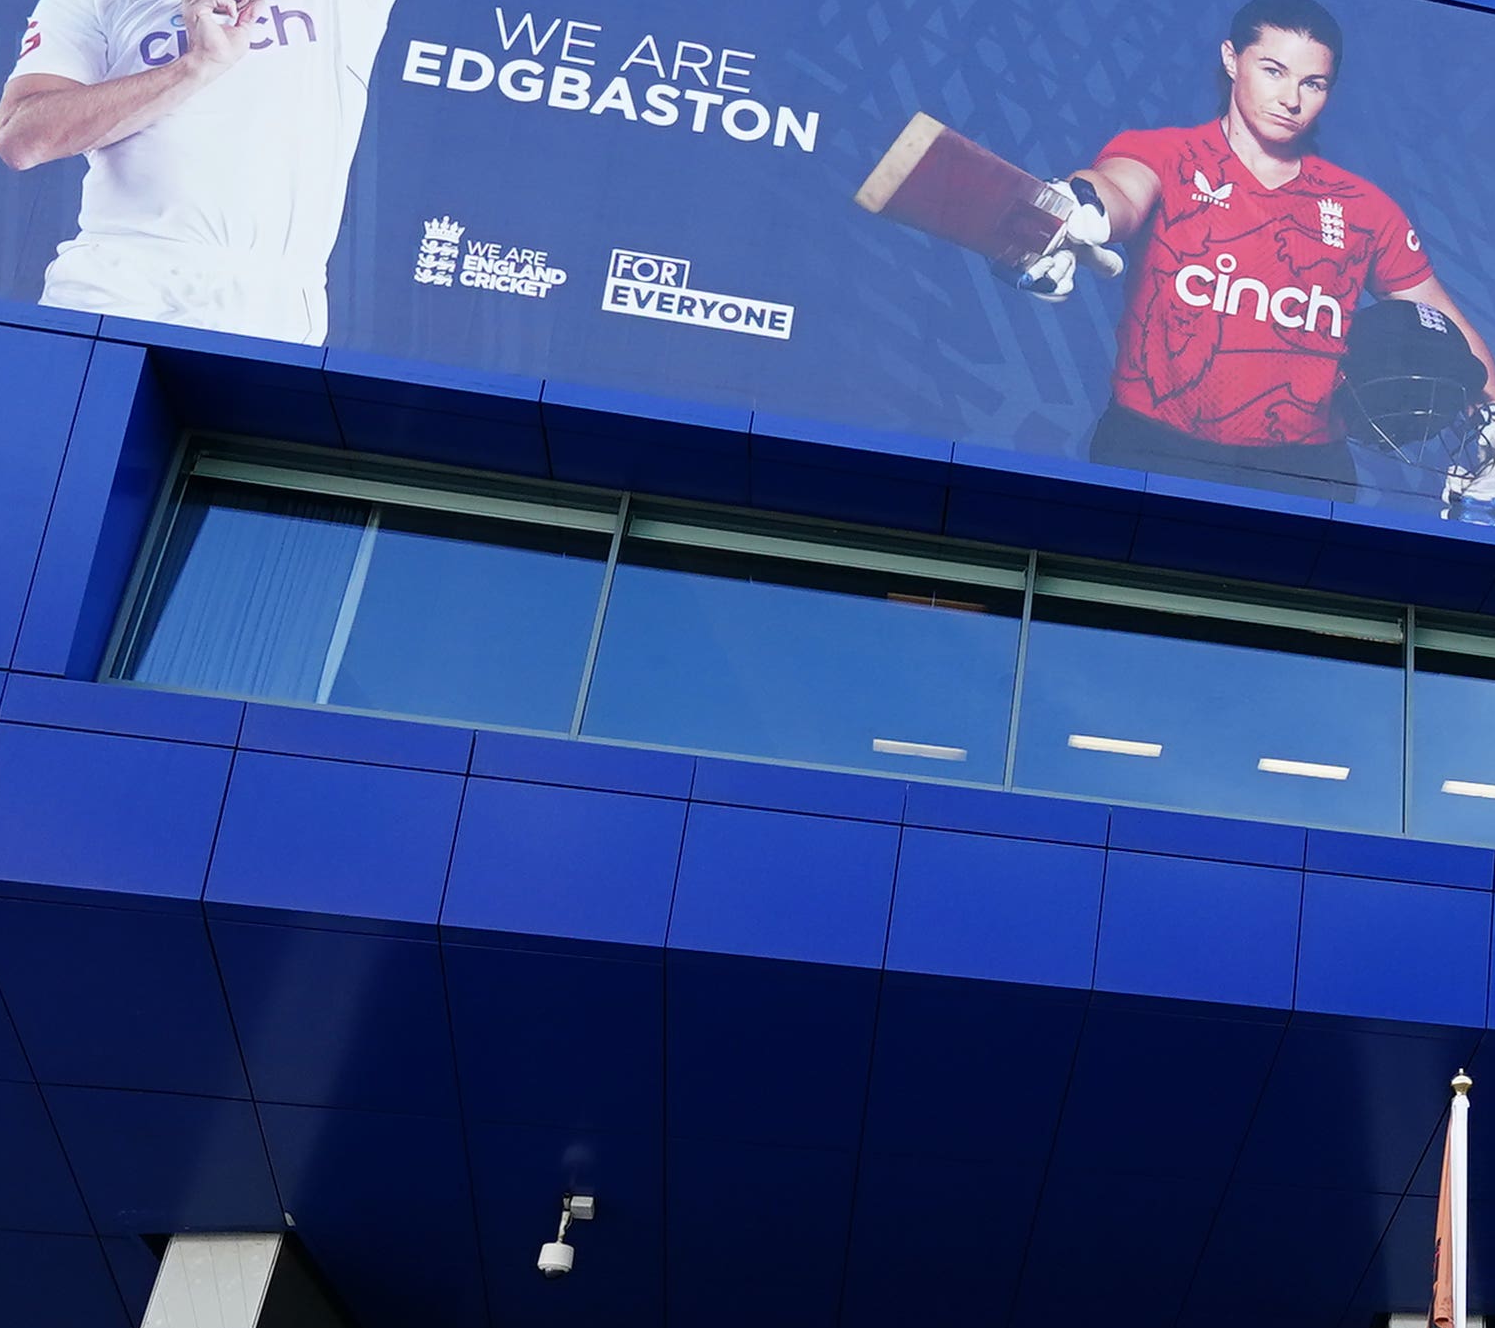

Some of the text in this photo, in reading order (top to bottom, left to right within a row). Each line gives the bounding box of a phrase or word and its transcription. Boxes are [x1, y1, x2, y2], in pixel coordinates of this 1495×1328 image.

[495, 7, 756, 95] WE ARE
[402, 42, 819, 153] EDGBASTON
[462, 255, 568, 285] ENGLAND
[466, 240, 548, 266] WE ARE
[615, 256, 679, 286] FOR
[459, 271, 552, 299] CRICKET
[1175, 253, 1342, 338] cinch
[611, 285, 788, 333] EVERYONE
